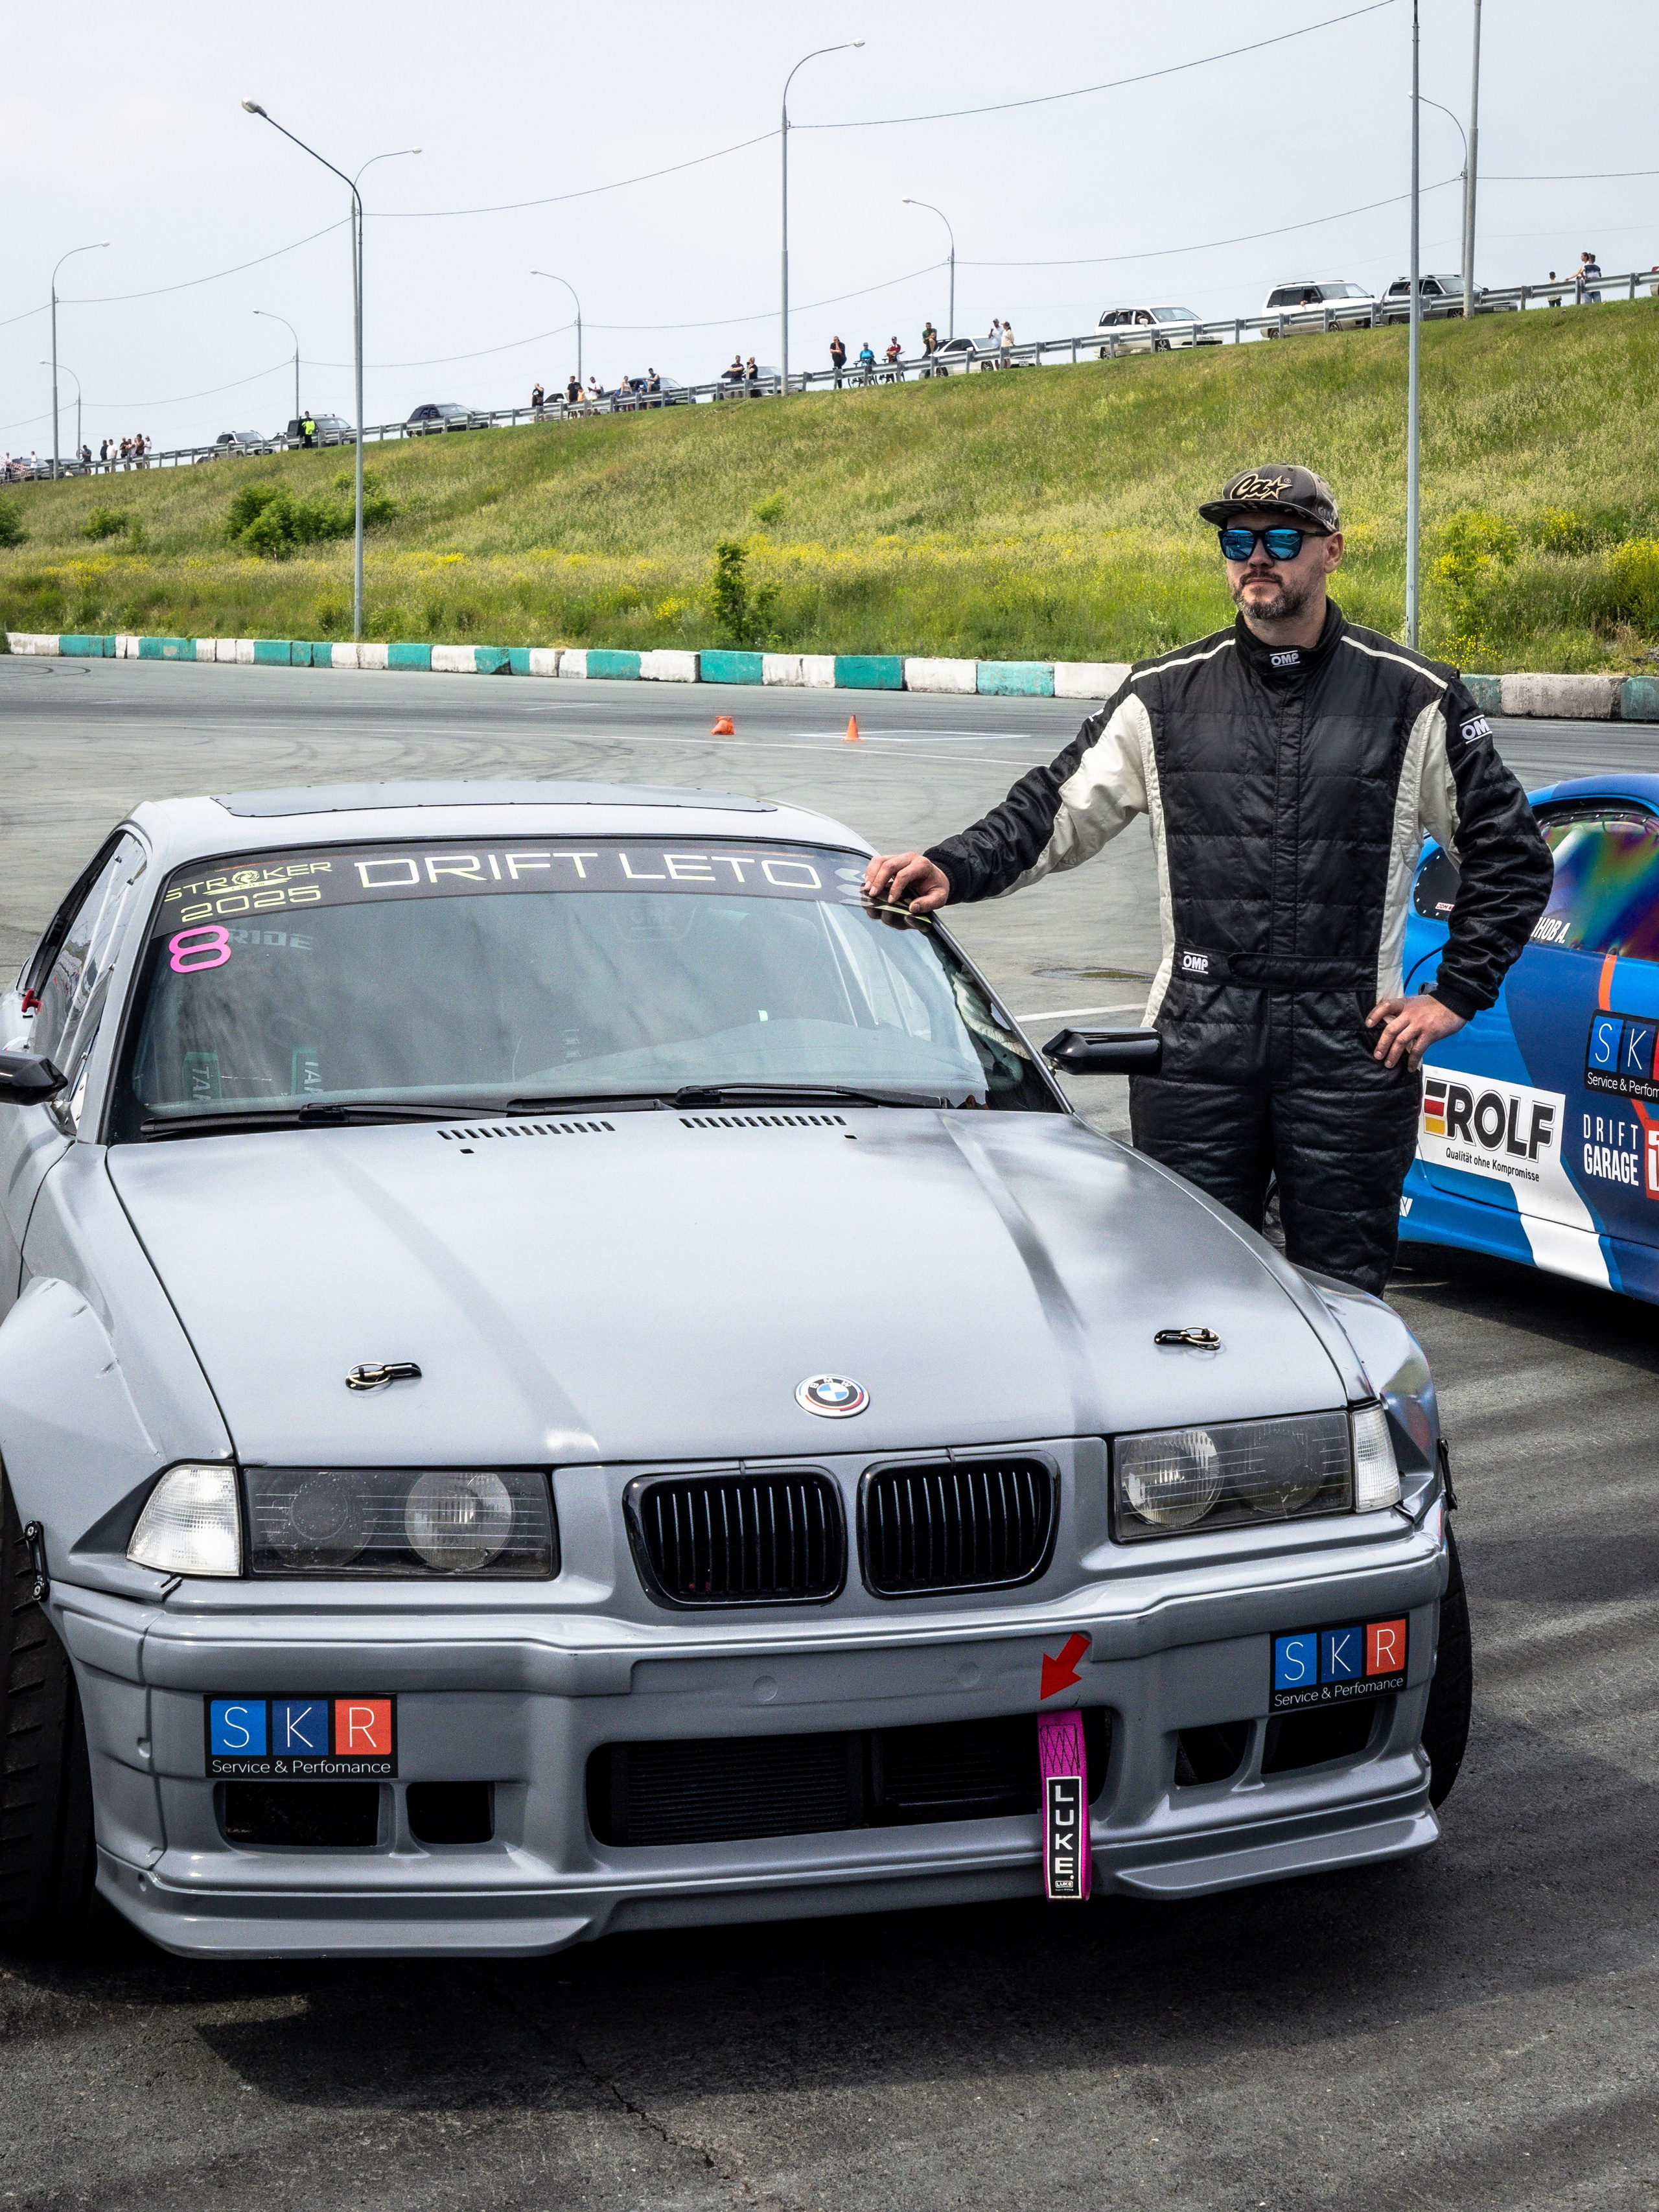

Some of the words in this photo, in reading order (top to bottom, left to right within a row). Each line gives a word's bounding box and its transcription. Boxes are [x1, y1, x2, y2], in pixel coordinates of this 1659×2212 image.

[1271, 652, 1299, 667] OMP
[354, 852, 598, 888] DRIFT
[619, 853, 822, 889] LETO
[180, 885, 321, 922] 2025
[168, 925, 231, 973] 8
[208, 928, 312, 950] RIDE
[1183, 955, 1209, 971] OMP
[1587, 1072, 1618, 1089] Service
[1619, 1078, 1627, 1091] &
[1446, 1082, 1556, 1163] ROLF
[1583, 1113, 1638, 1150] DRIFT
[1446, 1147, 1472, 1164] Qualität
[1474, 1156, 1491, 1169] ohne
[1492, 1159, 1540, 1182] Kompromisse
[1583, 1143, 1639, 1186] GARAGE
[809, 1378, 852, 1389] BMW
[1274, 1691, 1319, 1707] Service
[1321, 1687, 1331, 1699] &
[1334, 1677, 1404, 1697] Perfomance
[212, 1760, 270, 1773] Service
[275, 1760, 288, 1773] &
[293, 1760, 391, 1773] Perfomance
